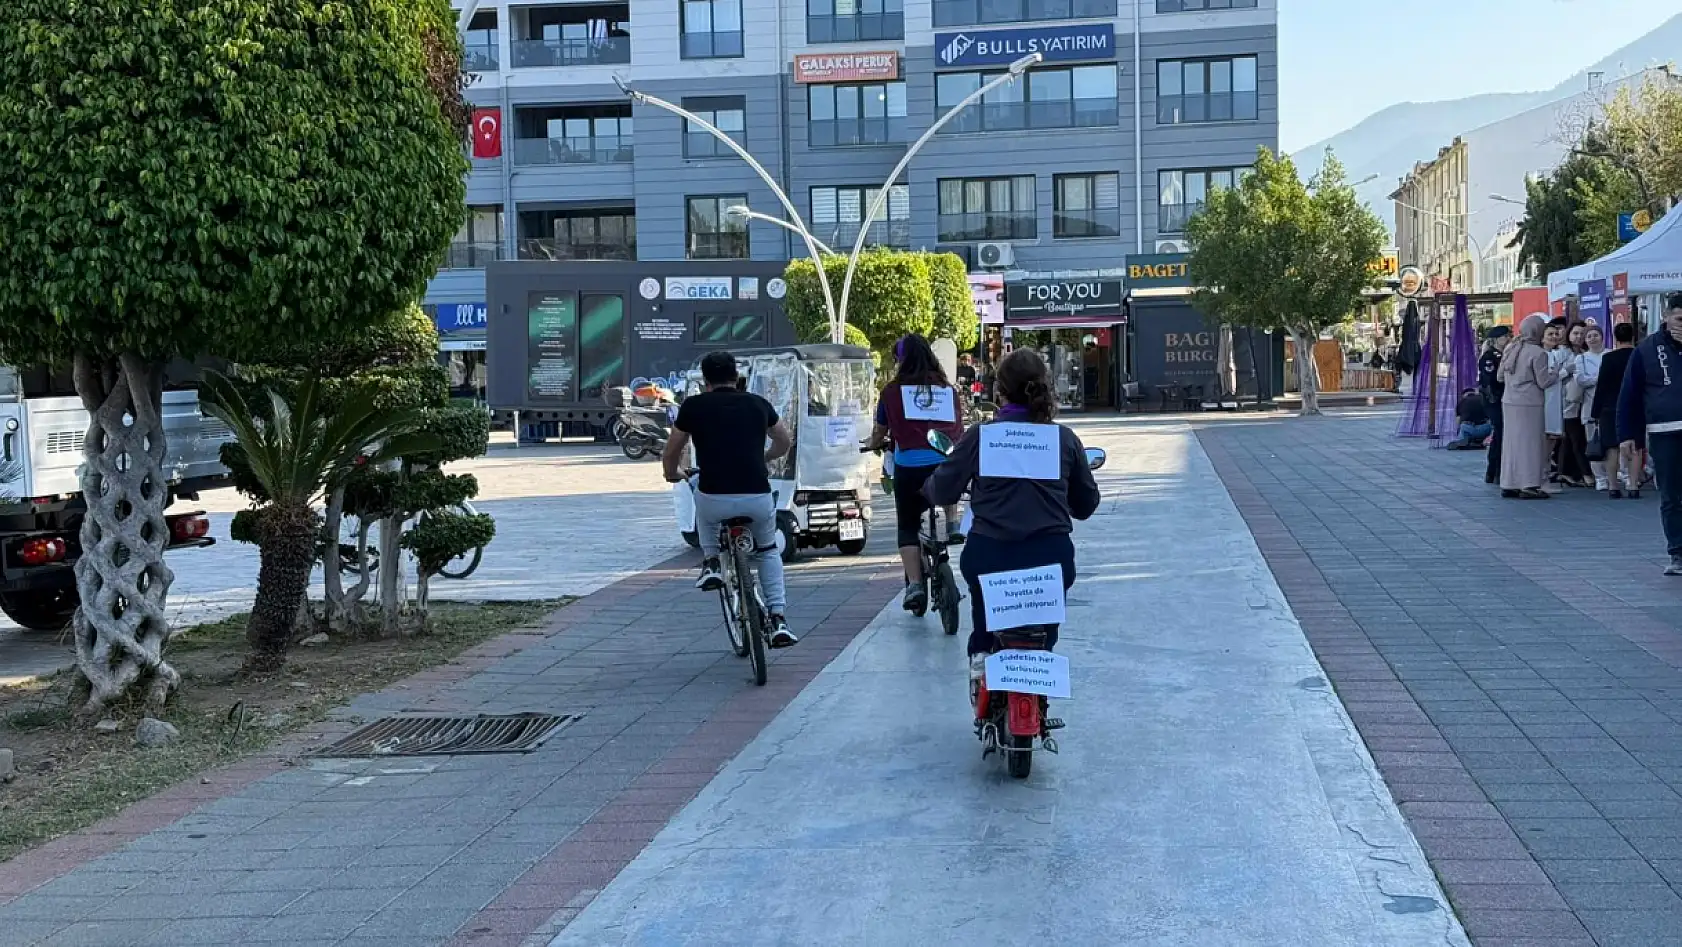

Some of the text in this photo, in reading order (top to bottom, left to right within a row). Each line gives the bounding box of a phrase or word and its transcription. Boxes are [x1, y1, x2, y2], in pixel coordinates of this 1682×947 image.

[977, 34, 1107, 55] BULLS YATIRIM
[855, 55, 893, 69] PERUK
[1129, 263, 1188, 279] BAGET
[687, 286, 730, 298] GEKA
[1028, 282, 1102, 301] FOR YOU
[1043, 301, 1085, 315] Boutique
[1164, 350, 1218, 363] BURG
[1022, 574, 1043, 586] yolda
[1004, 587, 1044, 598] hayatta da
[992, 599, 1058, 614] yaşamak istiyoruz!
[1038, 653, 1055, 663] her
[1006, 665, 1049, 674] türlüsüne
[1000, 676, 1056, 687] direniyoruz!
